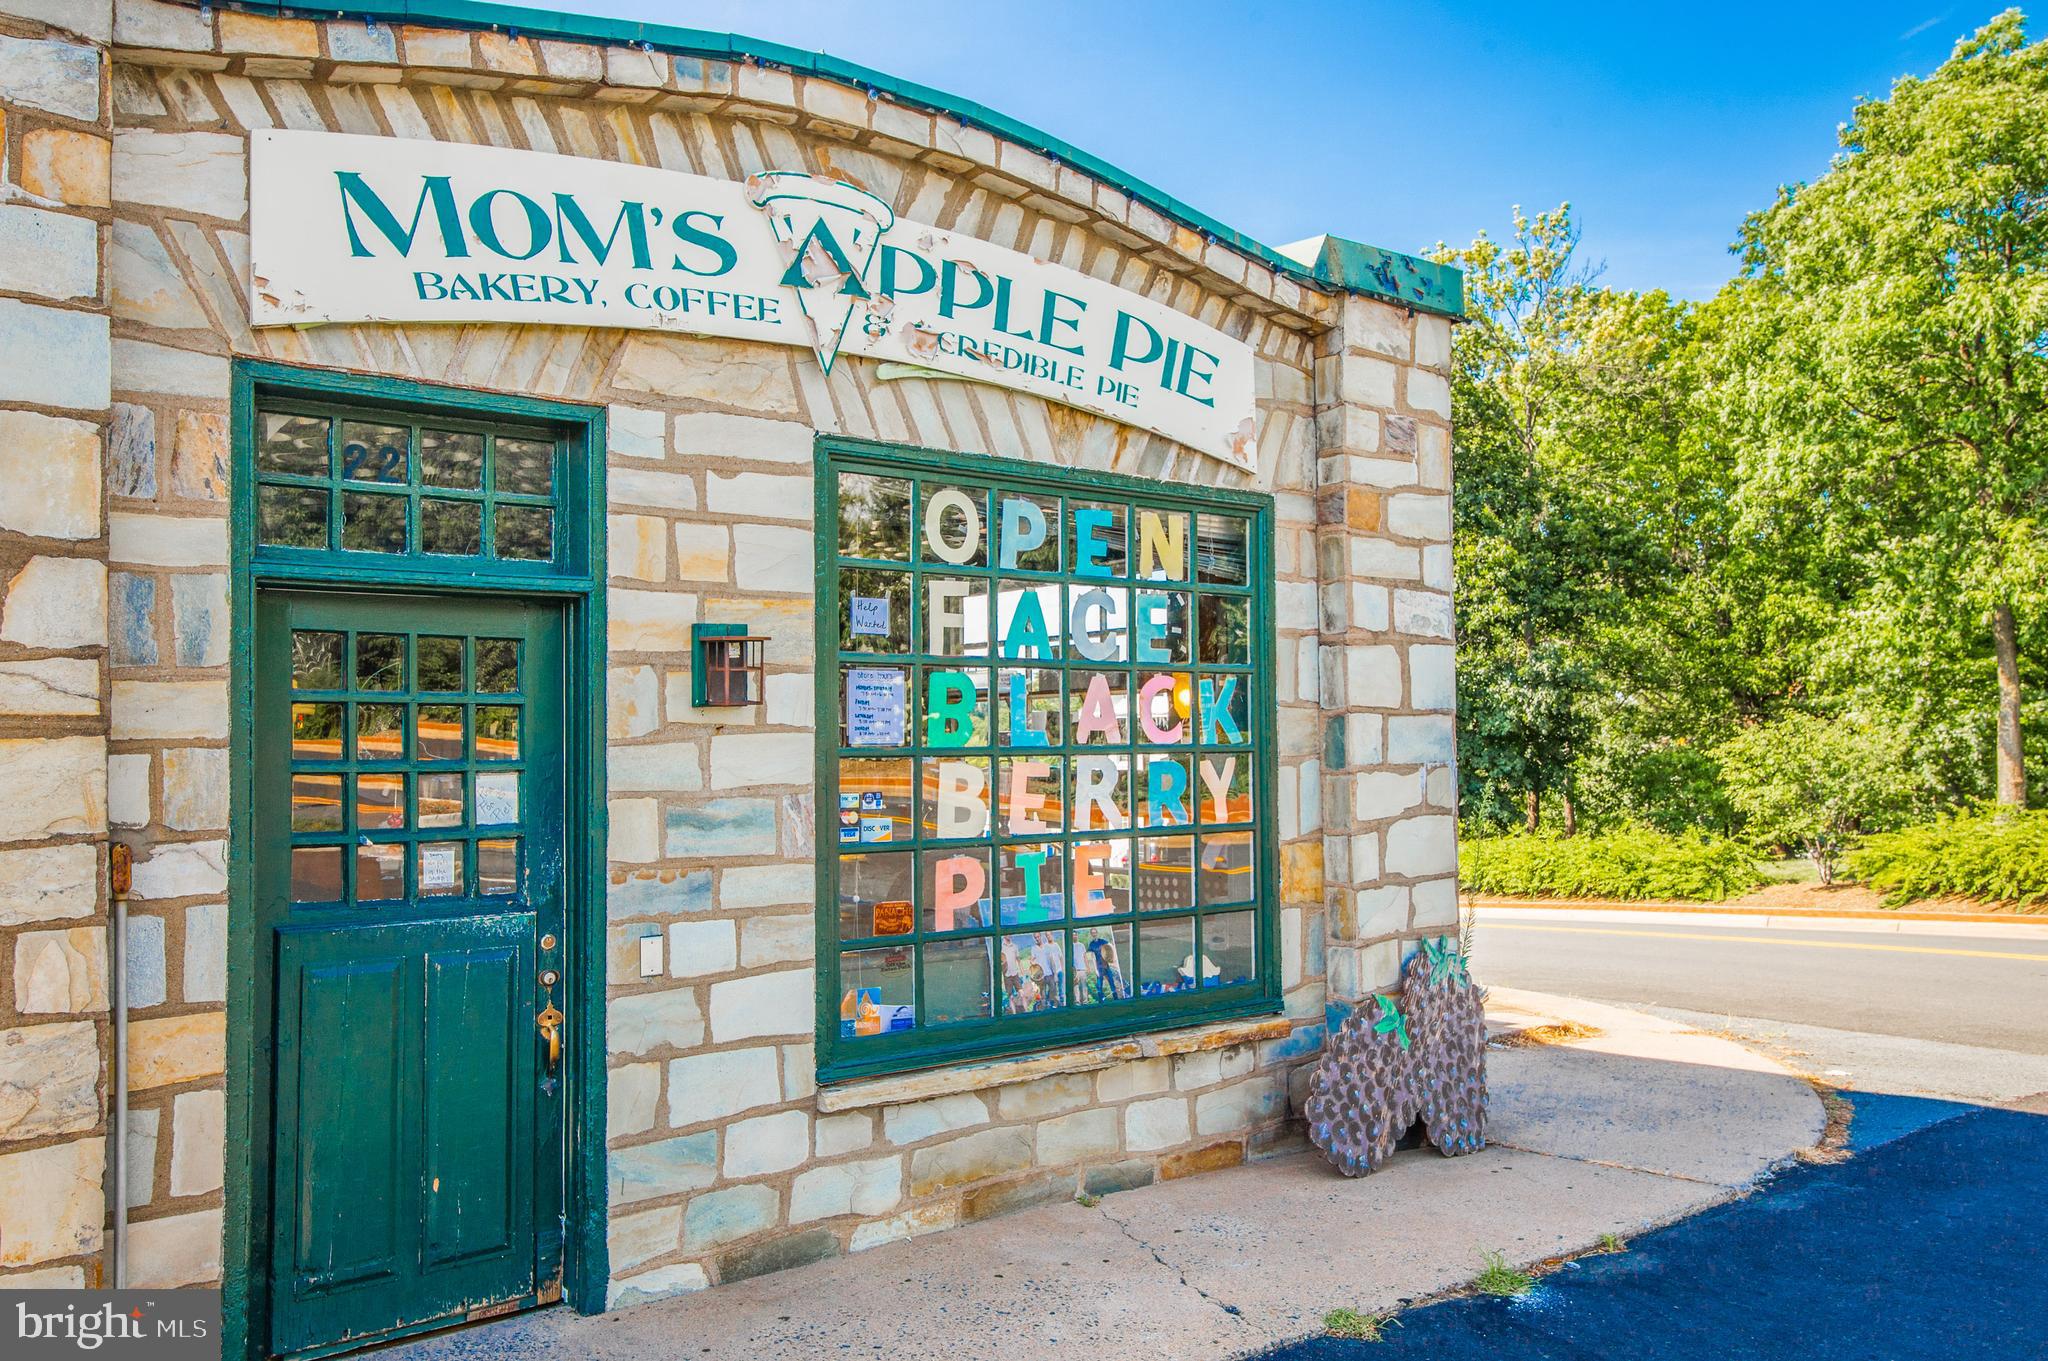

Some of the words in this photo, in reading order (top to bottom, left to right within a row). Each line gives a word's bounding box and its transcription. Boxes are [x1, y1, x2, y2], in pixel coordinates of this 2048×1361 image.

[333, 170, 738, 278] MOM'S
[779, 217, 1085, 357] APPLE
[1108, 309, 1220, 409] PIE
[413, 271, 608, 309] BAKERY,
[624, 283, 782, 325] COFFEE
[1096, 375, 1141, 409] PIE
[924, 489, 1185, 582] OPEN
[855, 614, 887, 630] Wanted
[857, 599, 879, 616] Help
[928, 580, 1173, 664] FACE
[926, 670, 1243, 748] BLACK
[863, 824, 890, 832] DISCOVER
[936, 754, 1237, 839] BERRY
[934, 843, 1113, 932] PIE
